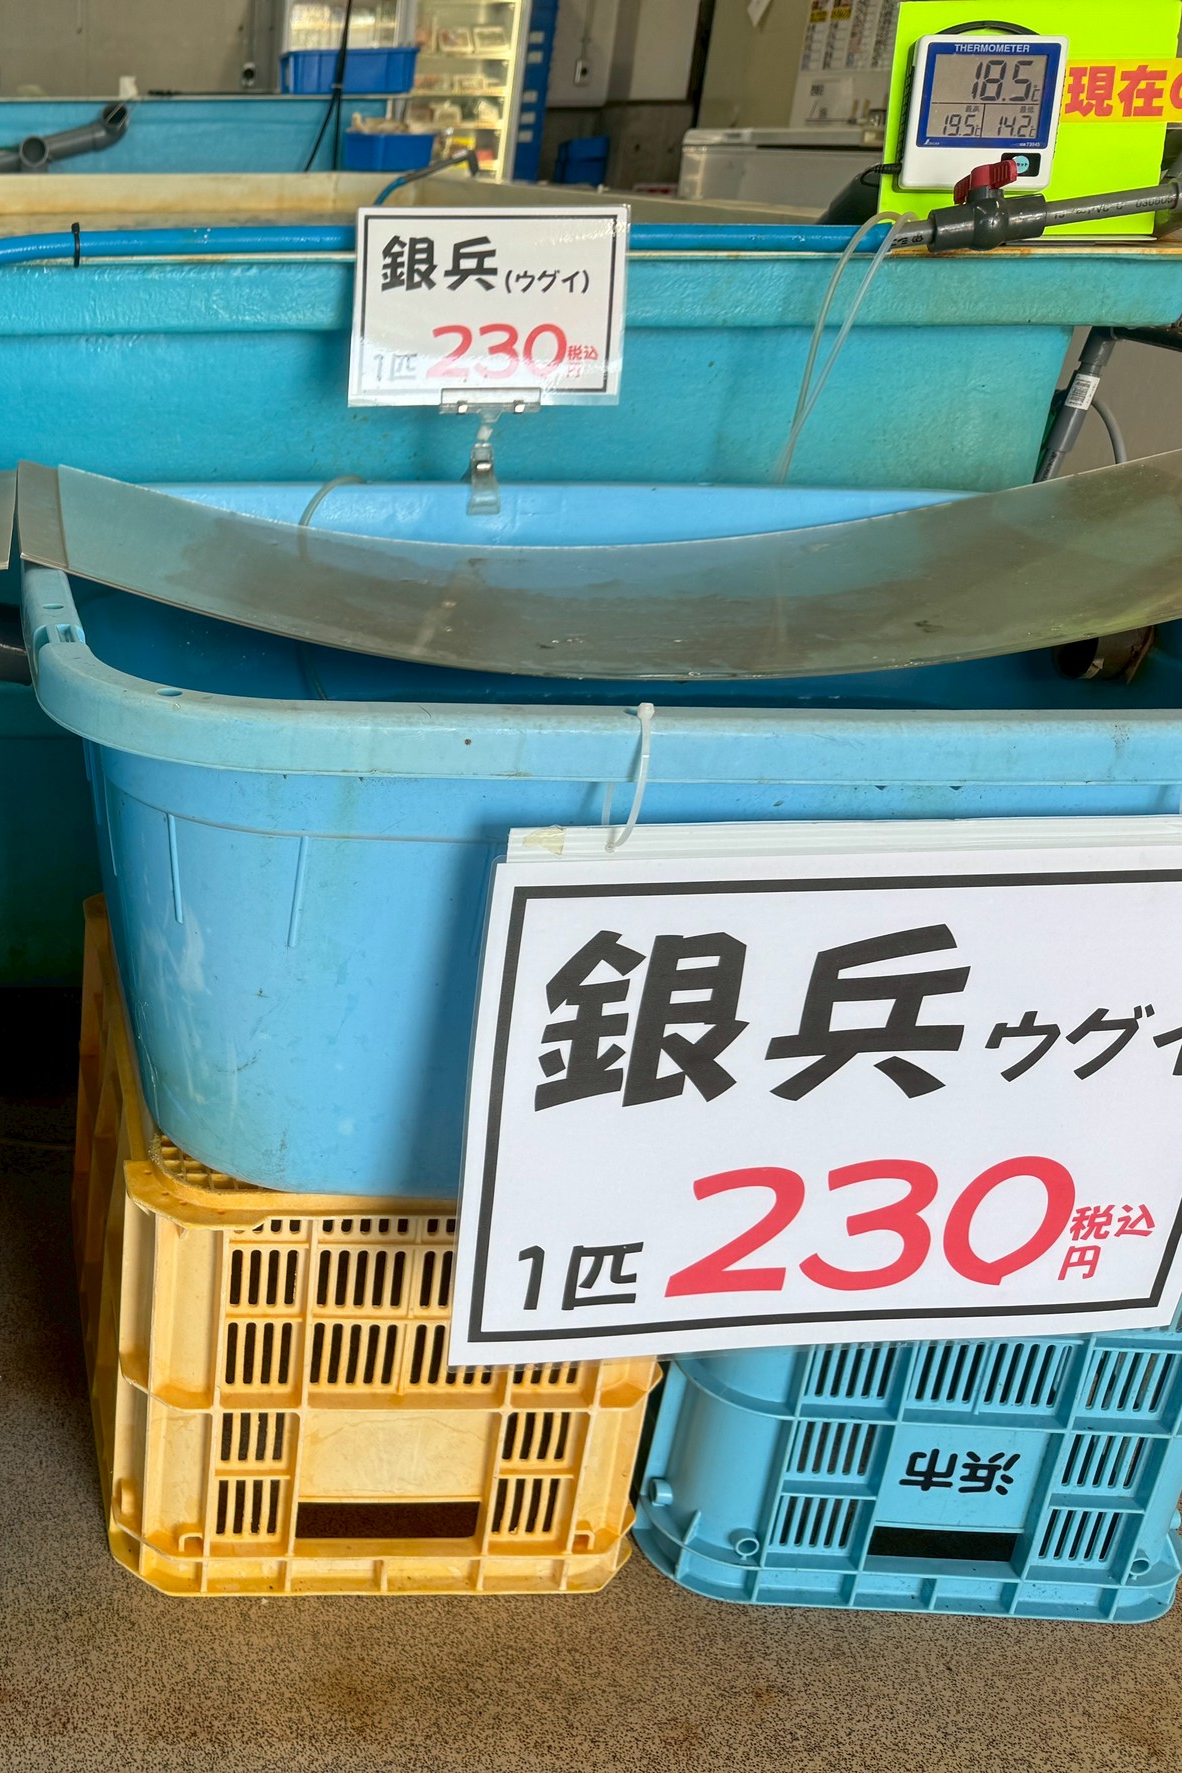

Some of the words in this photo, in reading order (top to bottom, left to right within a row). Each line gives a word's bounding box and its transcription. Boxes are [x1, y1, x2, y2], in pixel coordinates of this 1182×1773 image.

[954, 43, 1030, 53] THERMOMETER
[1064, 65, 1182, 117] 現在
[381, 235, 498, 292] 銀兵
[374, 352, 417, 382] 1匹
[426, 323, 567, 380] 230
[535, 924, 971, 1112] 銀兵
[518, 1242, 644, 1311] 1匹
[665, 1156, 1076, 1299] 230
[899, 1448, 1021, 1496] 浜市
